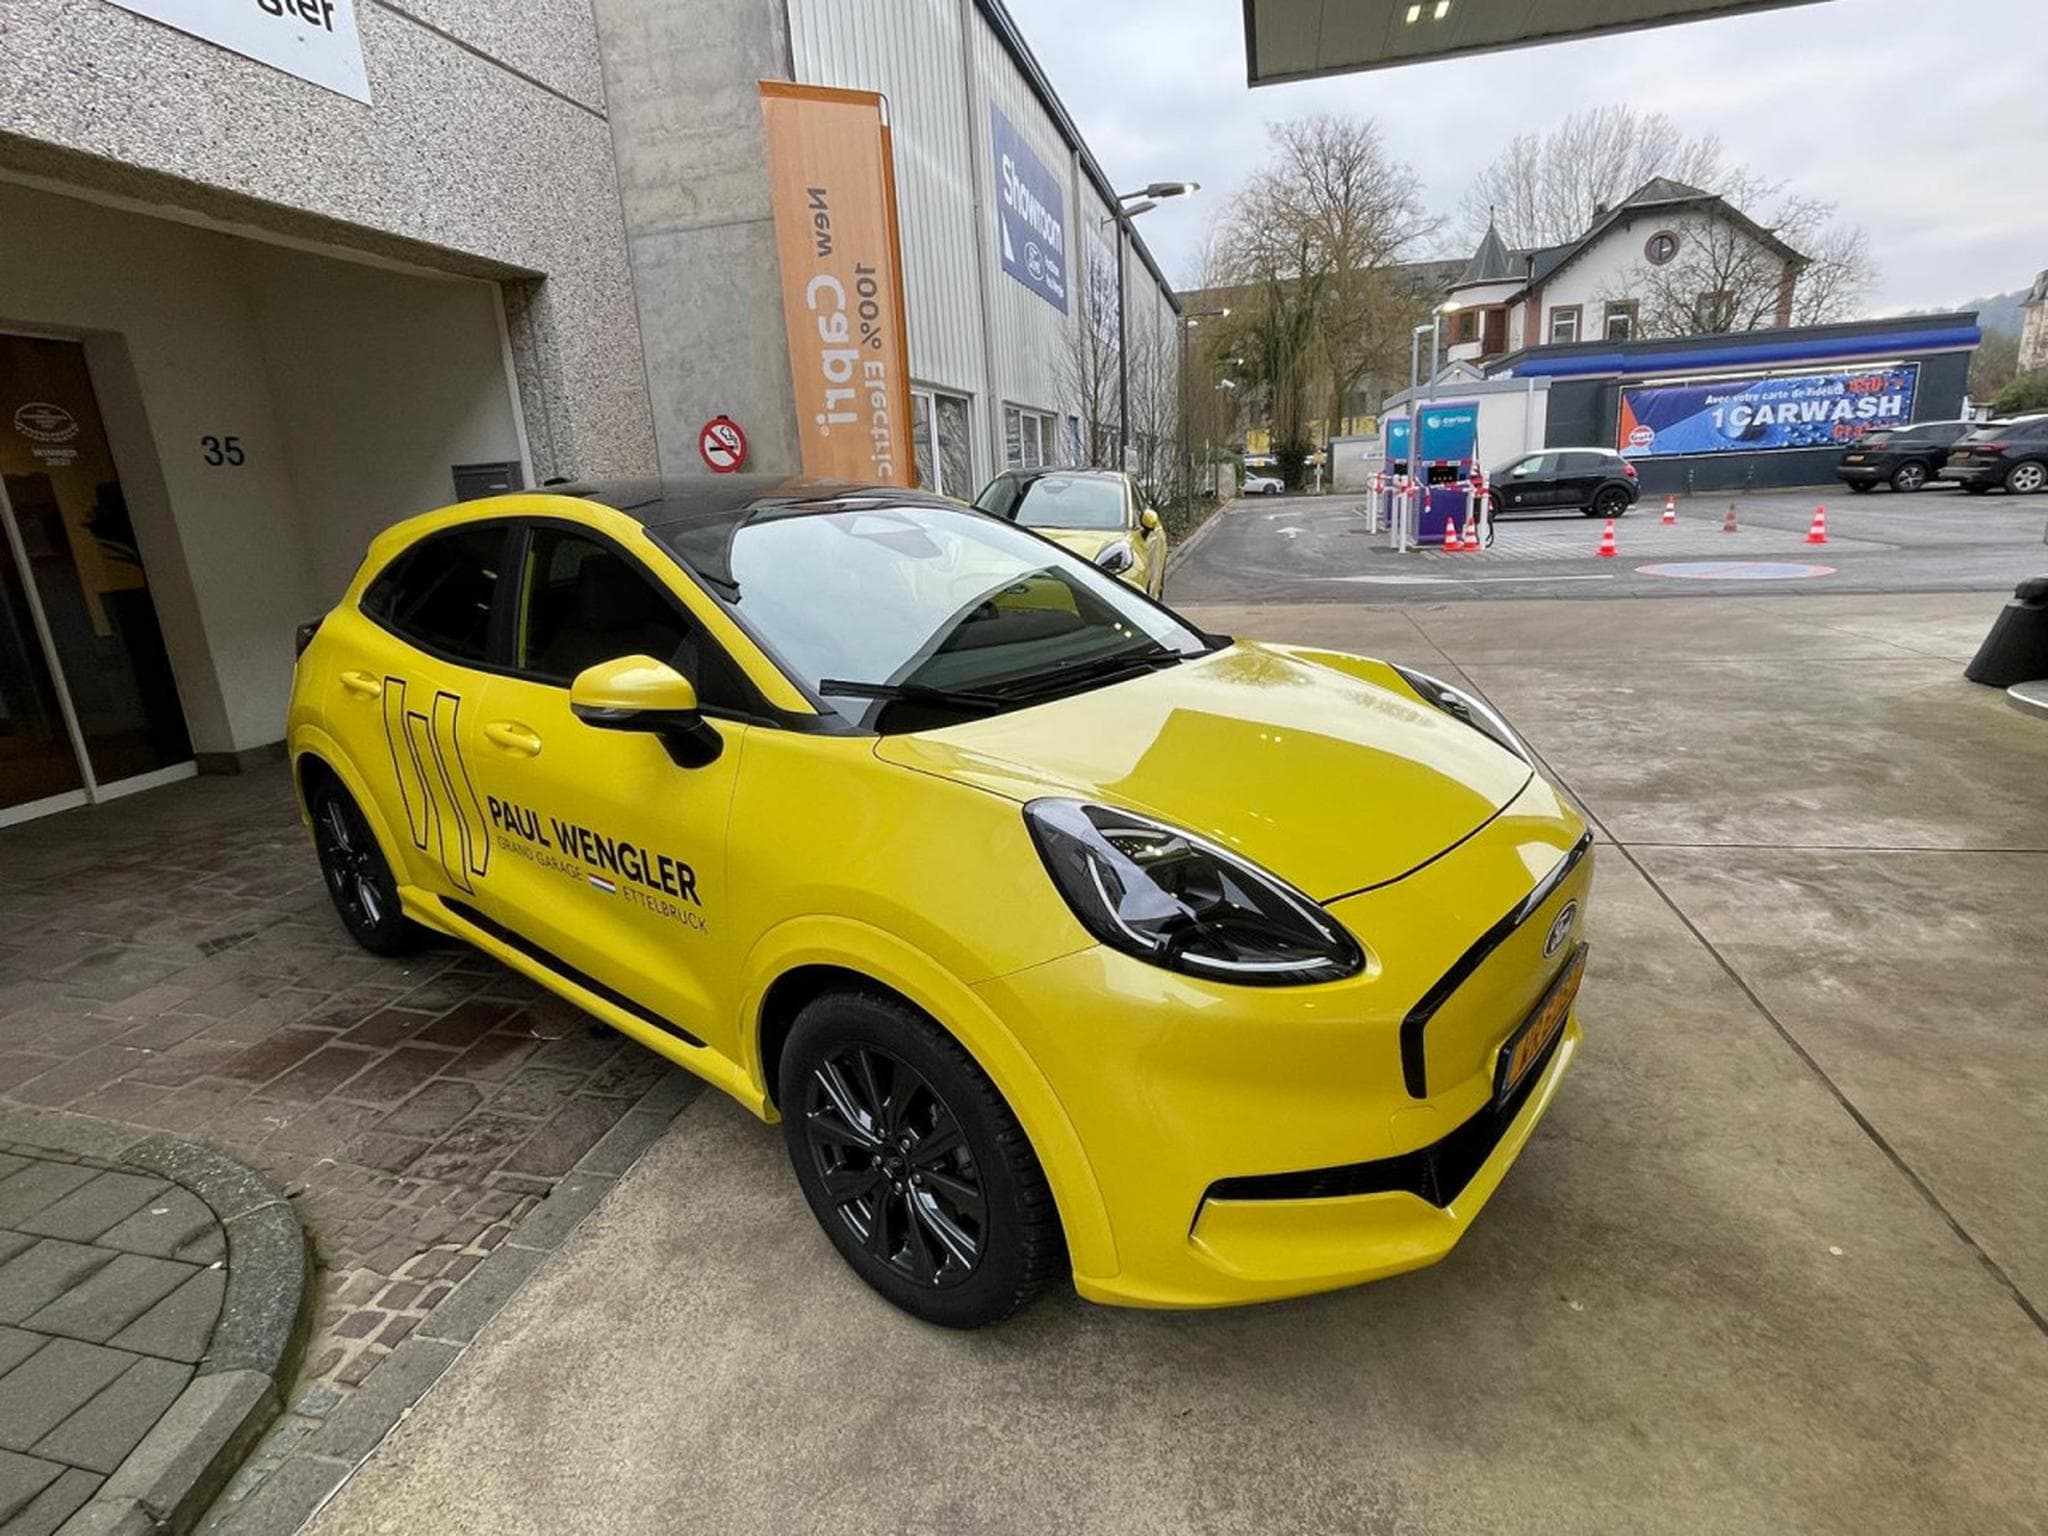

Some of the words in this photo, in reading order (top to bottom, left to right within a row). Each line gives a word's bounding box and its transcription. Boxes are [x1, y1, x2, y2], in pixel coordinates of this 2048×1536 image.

[1002, 153, 1063, 255] Showroom
[201, 435, 244, 467] 35
[1729, 394, 1902, 427] CARWASH
[487, 795, 551, 848] PAUL
[551, 817, 703, 907] WENGLER
[497, 835, 536, 862] GRAND
[535, 850, 584, 882] GARAGE
[622, 885, 709, 934] ETTELBRUCK
